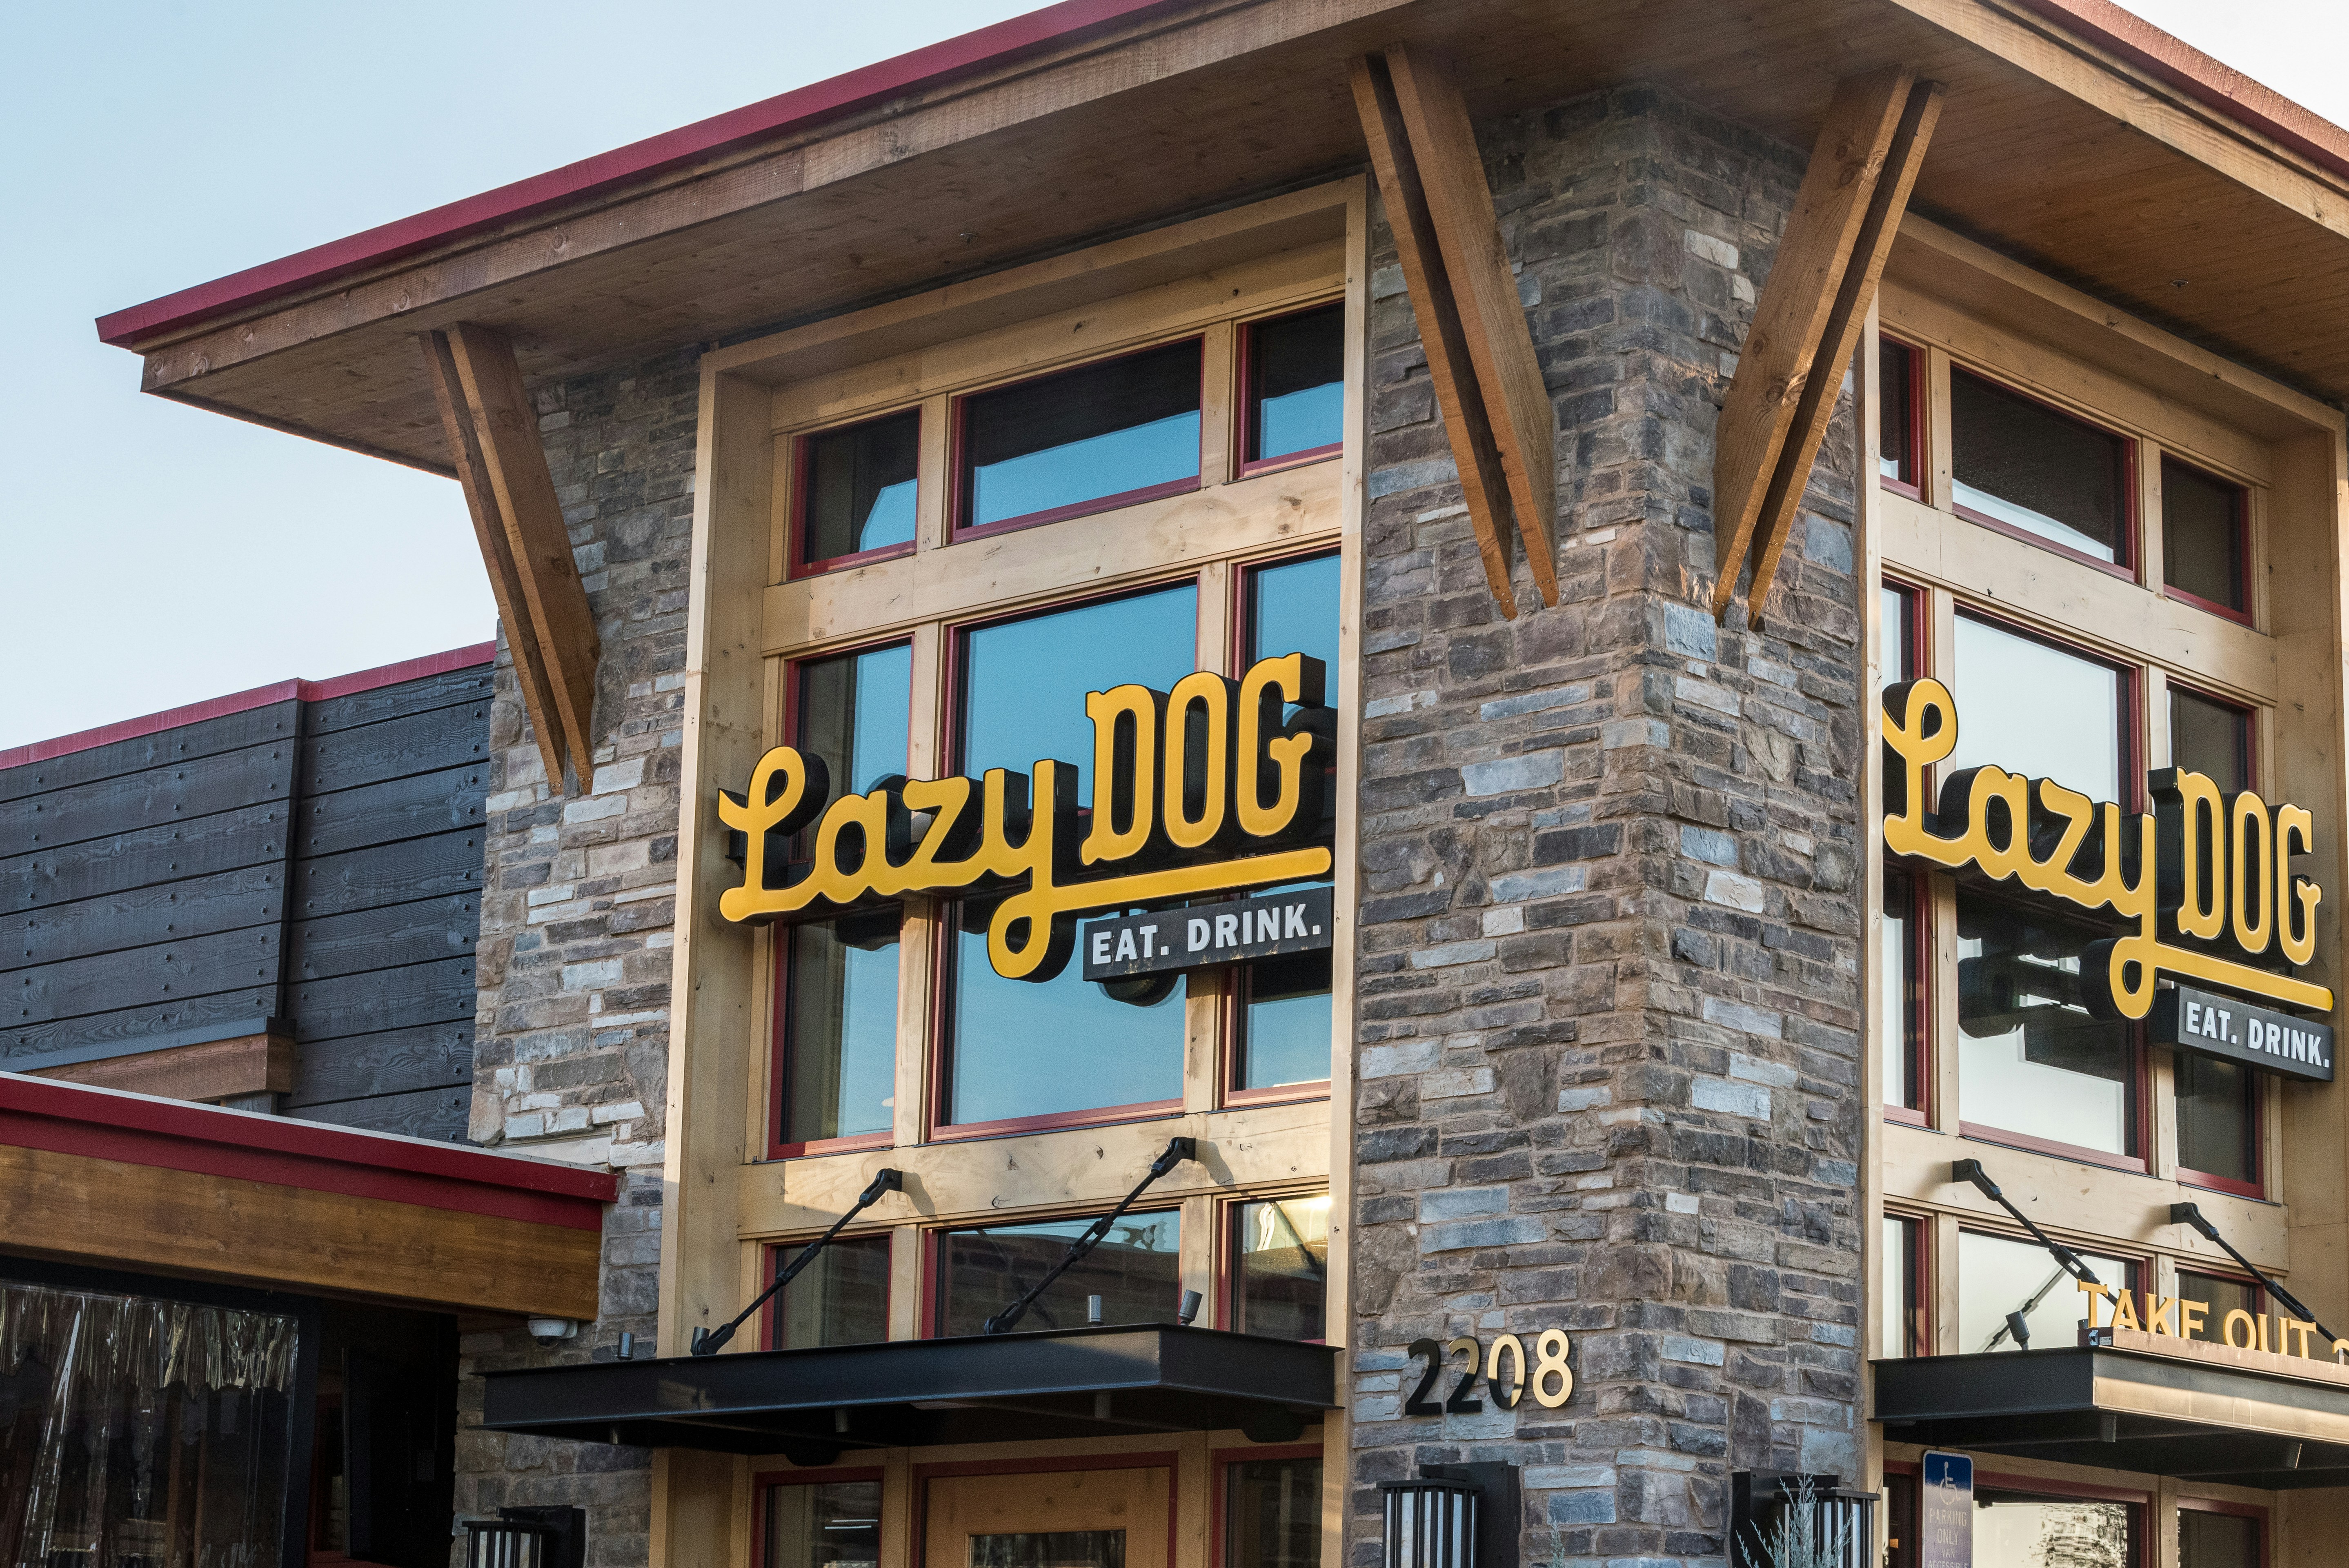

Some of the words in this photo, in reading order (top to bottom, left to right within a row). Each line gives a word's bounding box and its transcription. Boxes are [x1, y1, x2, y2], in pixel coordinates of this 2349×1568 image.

[718, 745, 1057, 980] Lazy
[1080, 652, 1313, 866] DOG
[1882, 677, 2157, 1019] Lazy
[2177, 766, 2322, 965] DOG
[1092, 925, 1169, 965] EAT.
[1188, 903, 1321, 952] DRINK.
[2186, 1001, 2237, 1044] EAT.
[2248, 1018, 2329, 1068] DRINK.
[2077, 1279, 2209, 1341] TAKE
[2223, 1309, 2317, 1359] OUT
[1405, 1328, 1575, 1416] 2208
[1929, 1508, 1967, 1527] PARKING
[1937, 1528, 1959, 1546] ONLY
[1941, 1548, 1955, 1559] VAN
